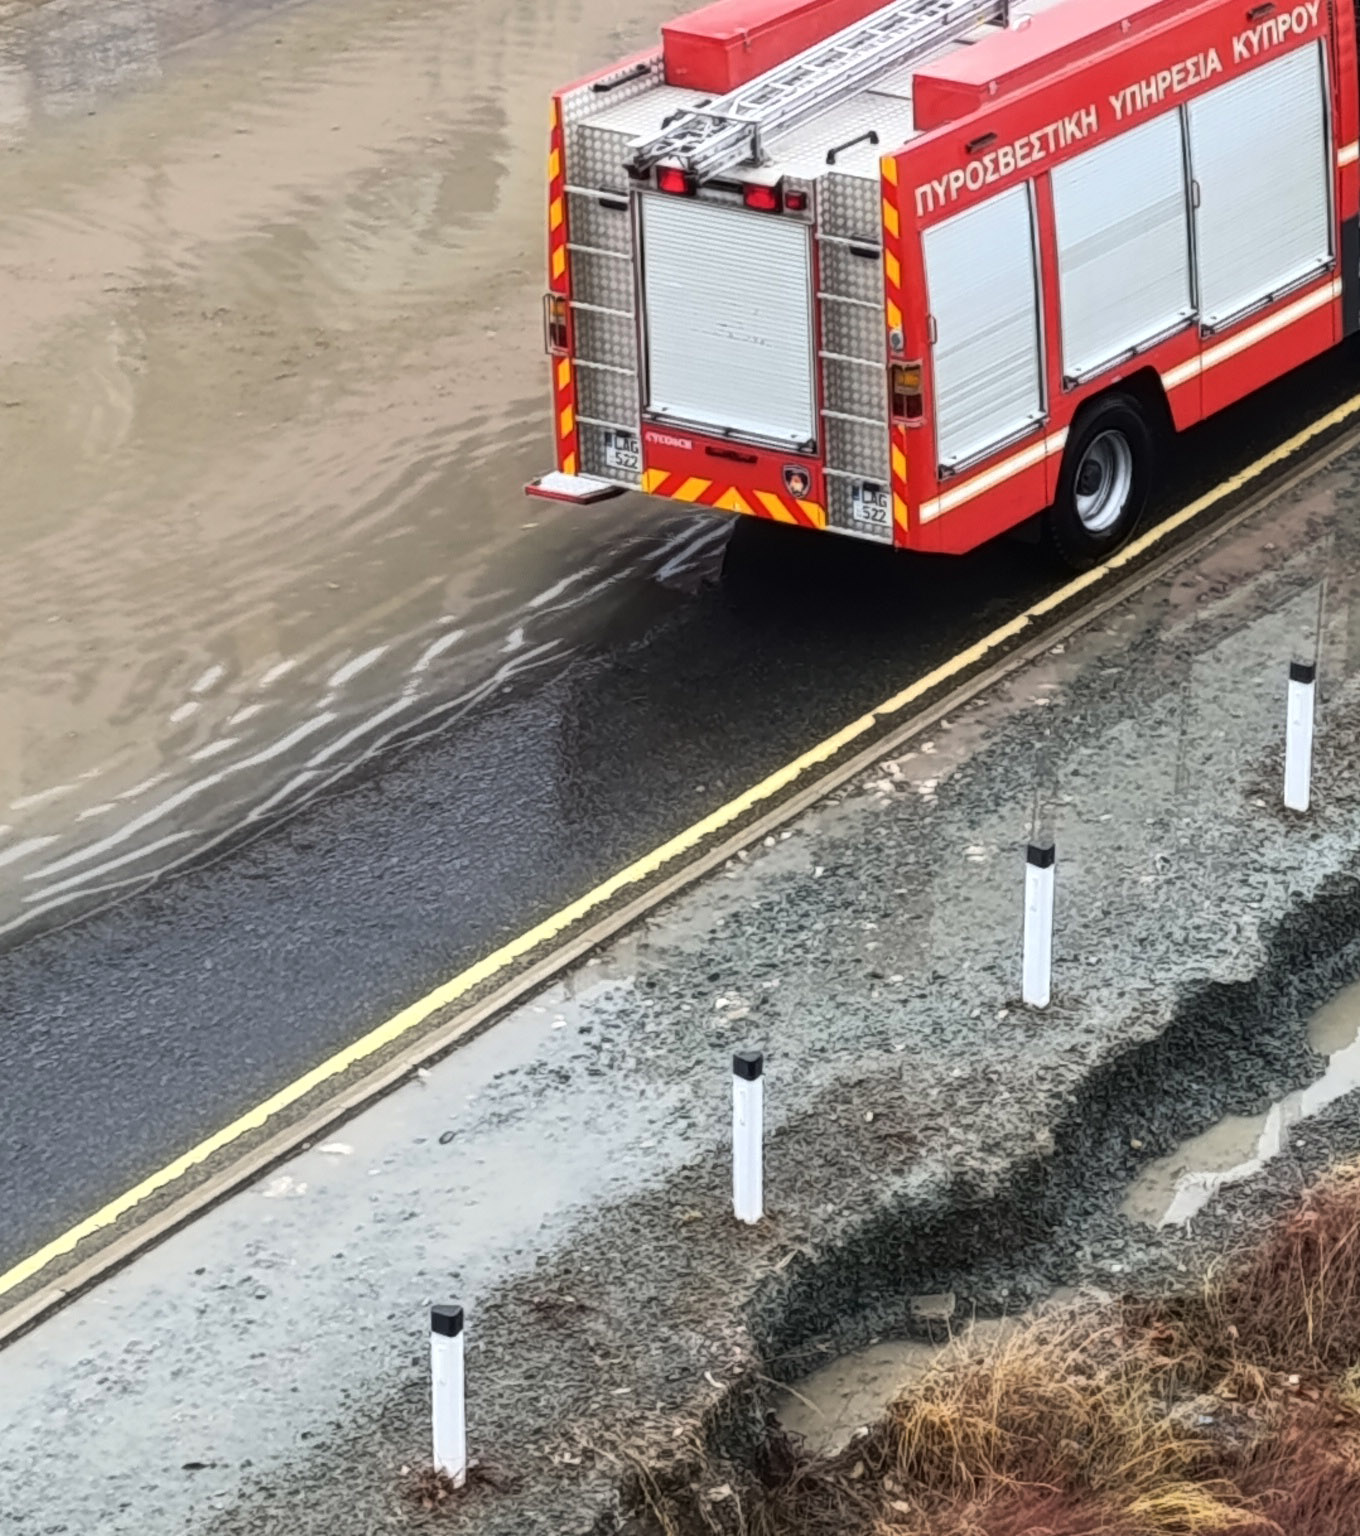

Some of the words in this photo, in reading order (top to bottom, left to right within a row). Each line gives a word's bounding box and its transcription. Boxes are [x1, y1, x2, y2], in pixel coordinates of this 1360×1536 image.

[914, 104, 1098, 217] ΠΥΡΟΣΒΕΣΤΙΚΗ
[1109, 48, 1223, 121] ΥΠΗΡΕΣΙΑ
[615, 434, 639, 454] LAG
[616, 452, 638, 470] 522
[862, 489, 888, 508] LAG
[862, 505, 887, 524] 522
